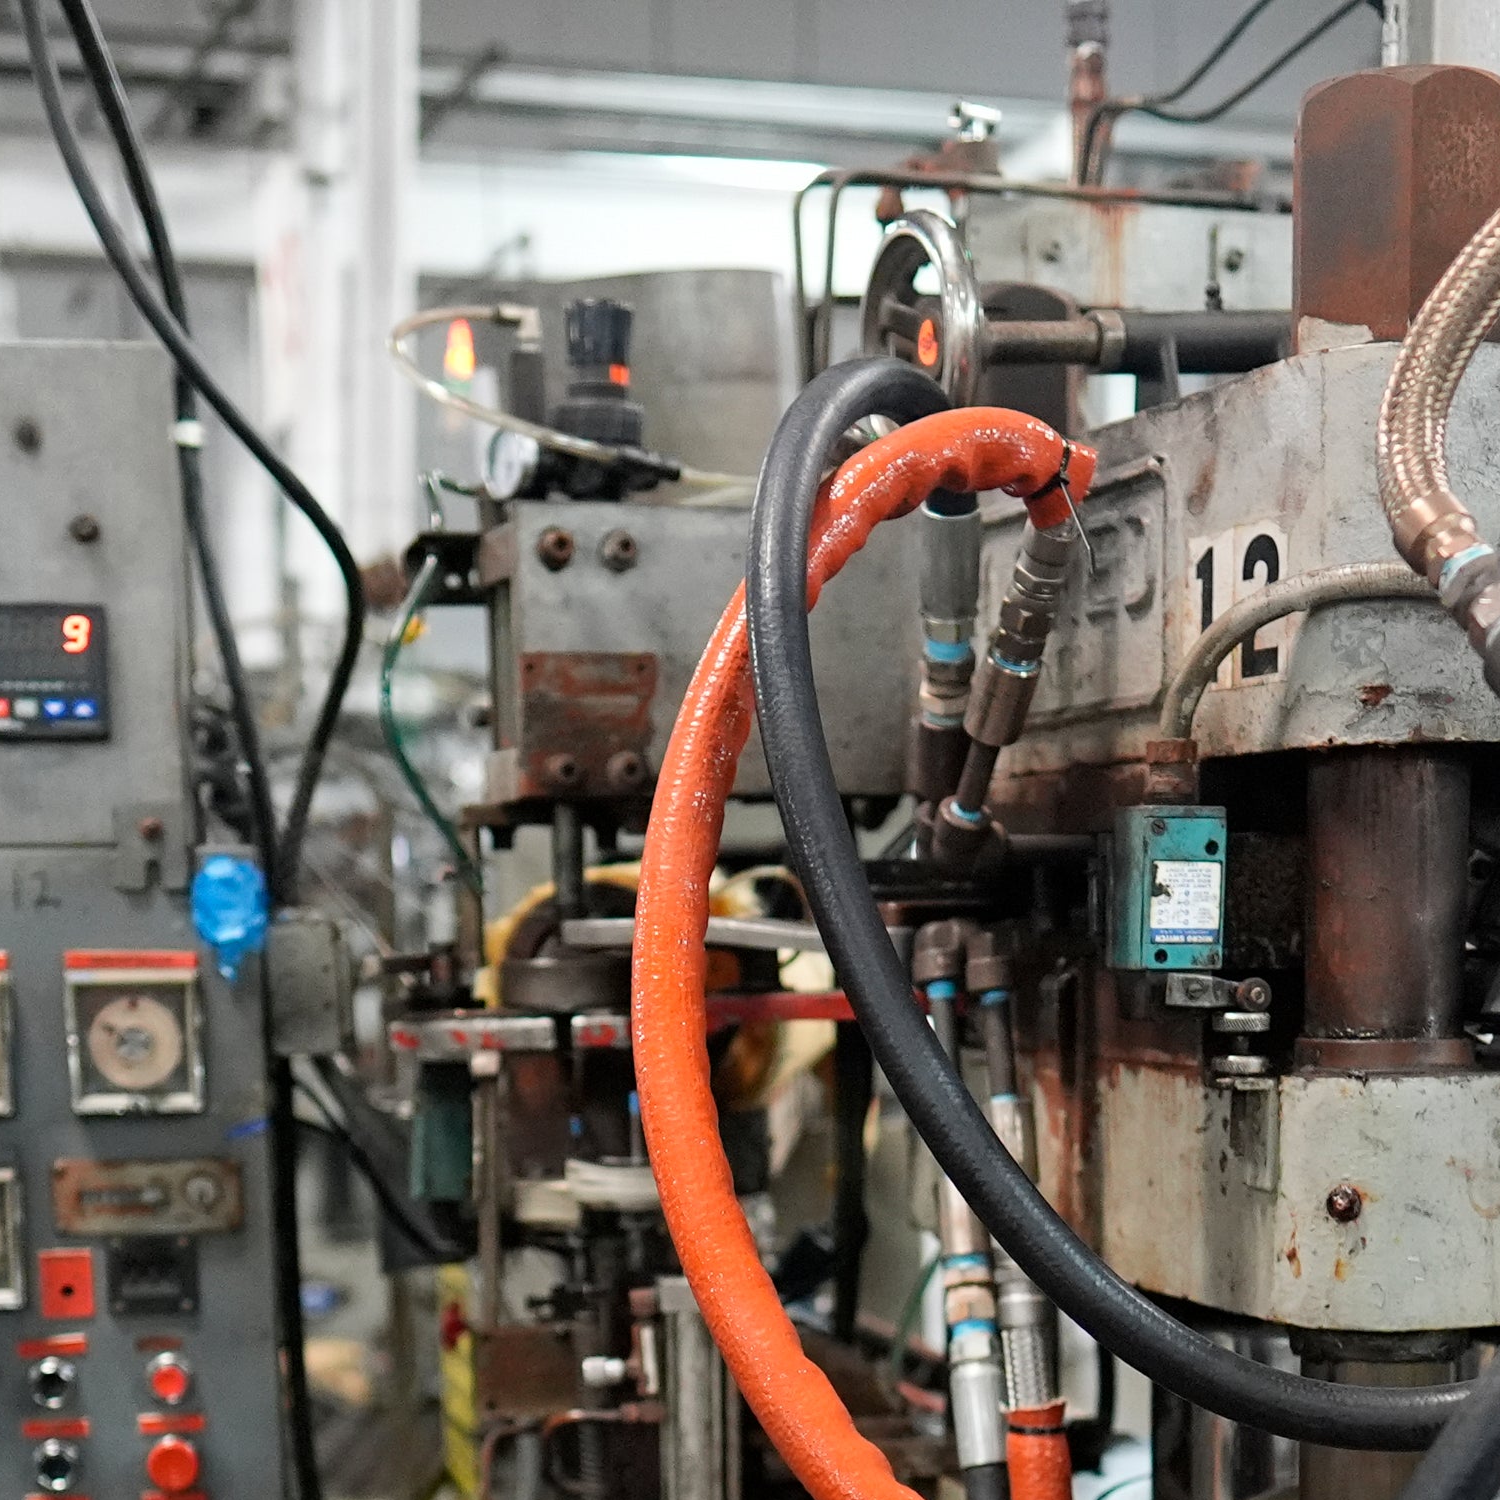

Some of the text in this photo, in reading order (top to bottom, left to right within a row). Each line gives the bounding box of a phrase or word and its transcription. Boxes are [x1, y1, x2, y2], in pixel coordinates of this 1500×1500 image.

[1196, 534, 1279, 683] 12
[61, 613, 93, 655] 9
[1154, 935, 1186, 943] SWITCH
